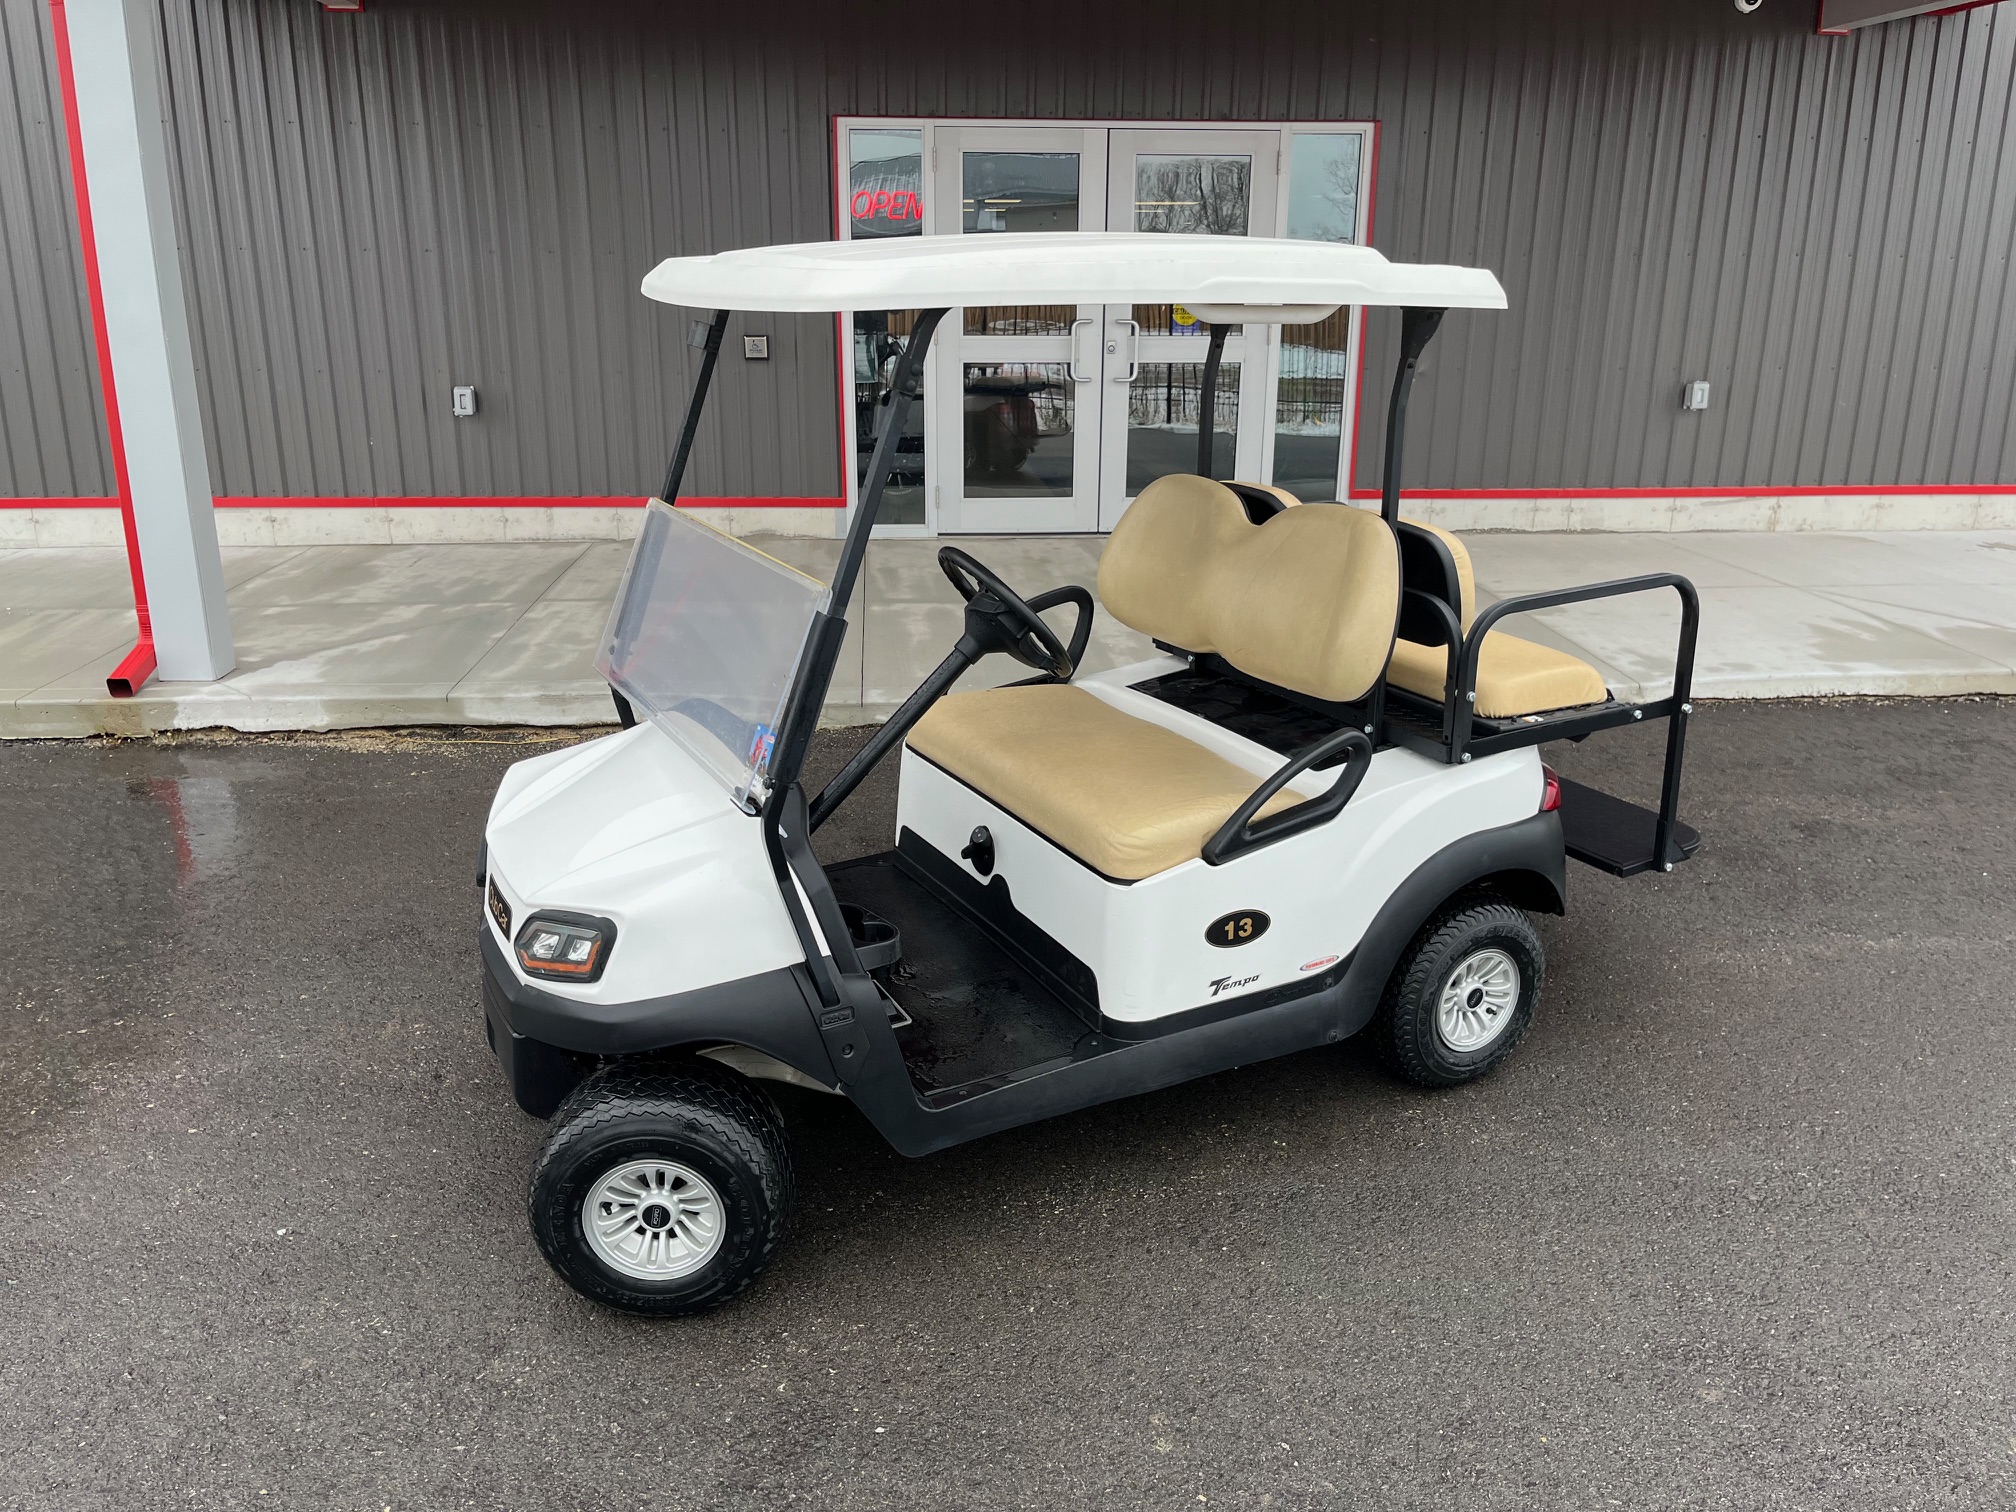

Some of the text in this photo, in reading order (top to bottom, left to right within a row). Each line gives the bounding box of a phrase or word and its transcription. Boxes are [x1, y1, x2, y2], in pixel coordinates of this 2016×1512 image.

[851, 190, 923, 220] OPEN
[1225, 918, 1253, 940] 13
[1209, 974, 1261, 997] Tempo
